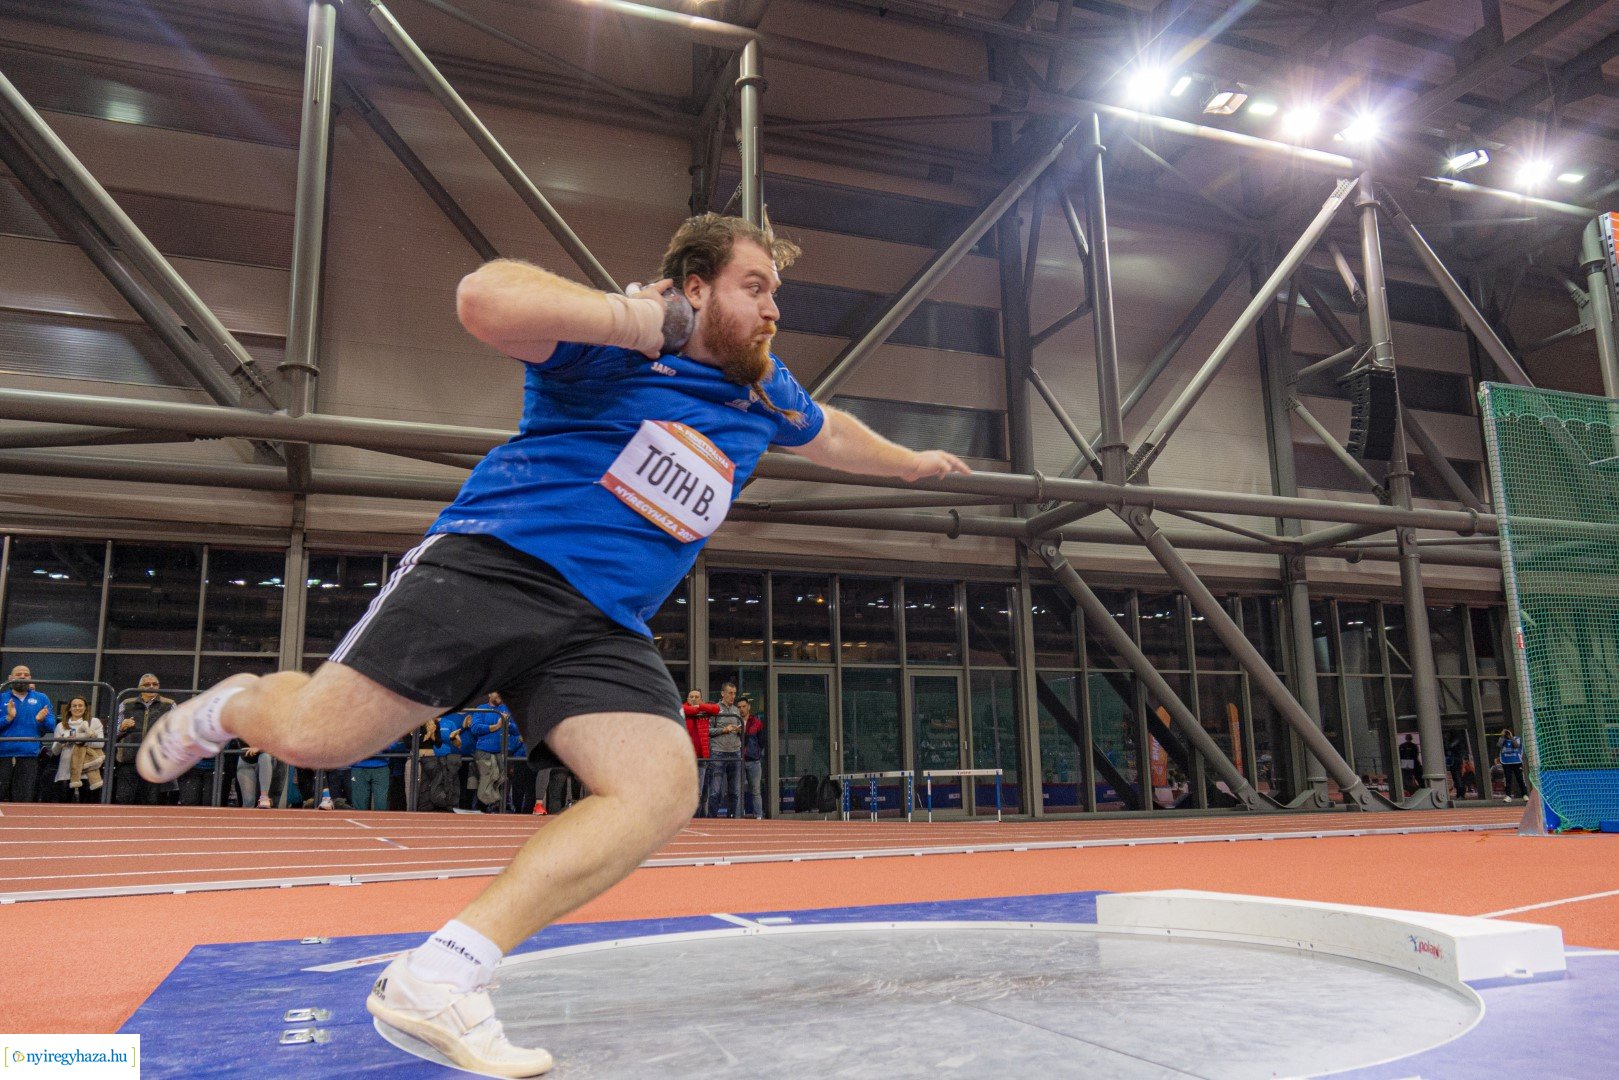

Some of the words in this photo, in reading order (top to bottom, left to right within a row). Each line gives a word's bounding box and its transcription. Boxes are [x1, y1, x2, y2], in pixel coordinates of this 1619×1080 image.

[651, 361, 677, 377] JAKO
[636, 444, 699, 506] TÓTH
[691, 484, 715, 522] B.
[615, 485, 679, 533] NYÍREGYHÁZA
[434, 937, 482, 965] adidas
